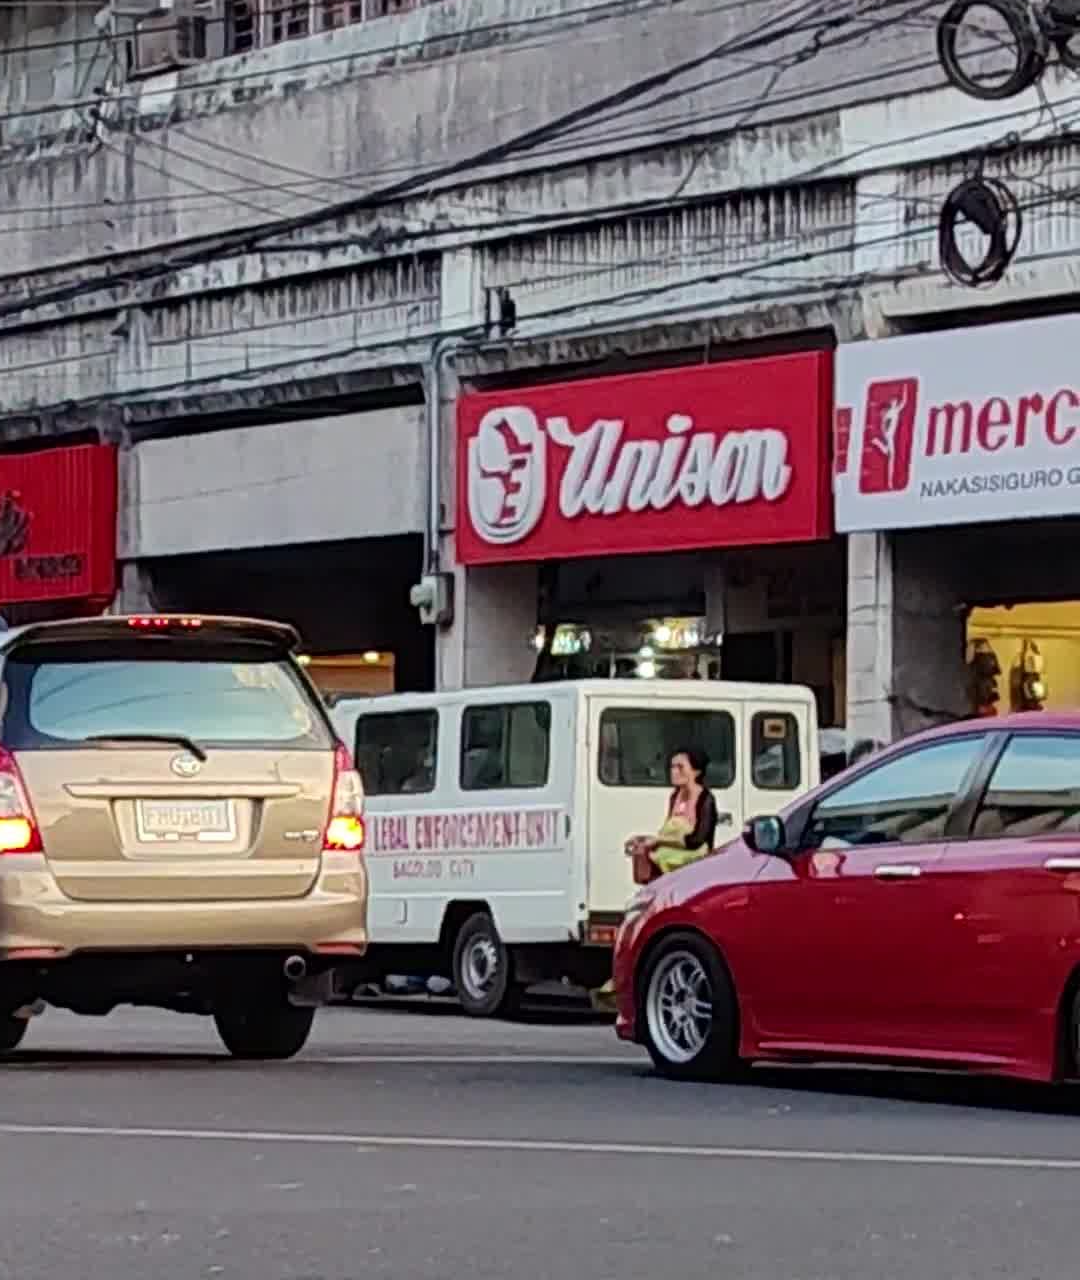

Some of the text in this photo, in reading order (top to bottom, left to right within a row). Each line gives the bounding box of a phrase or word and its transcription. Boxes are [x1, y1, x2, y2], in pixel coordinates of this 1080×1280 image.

[546, 414, 792, 519] Unison
[920, 467, 1064, 498] NAKASISIGURO
[415, 810, 521, 850] ENFORCEMENT
